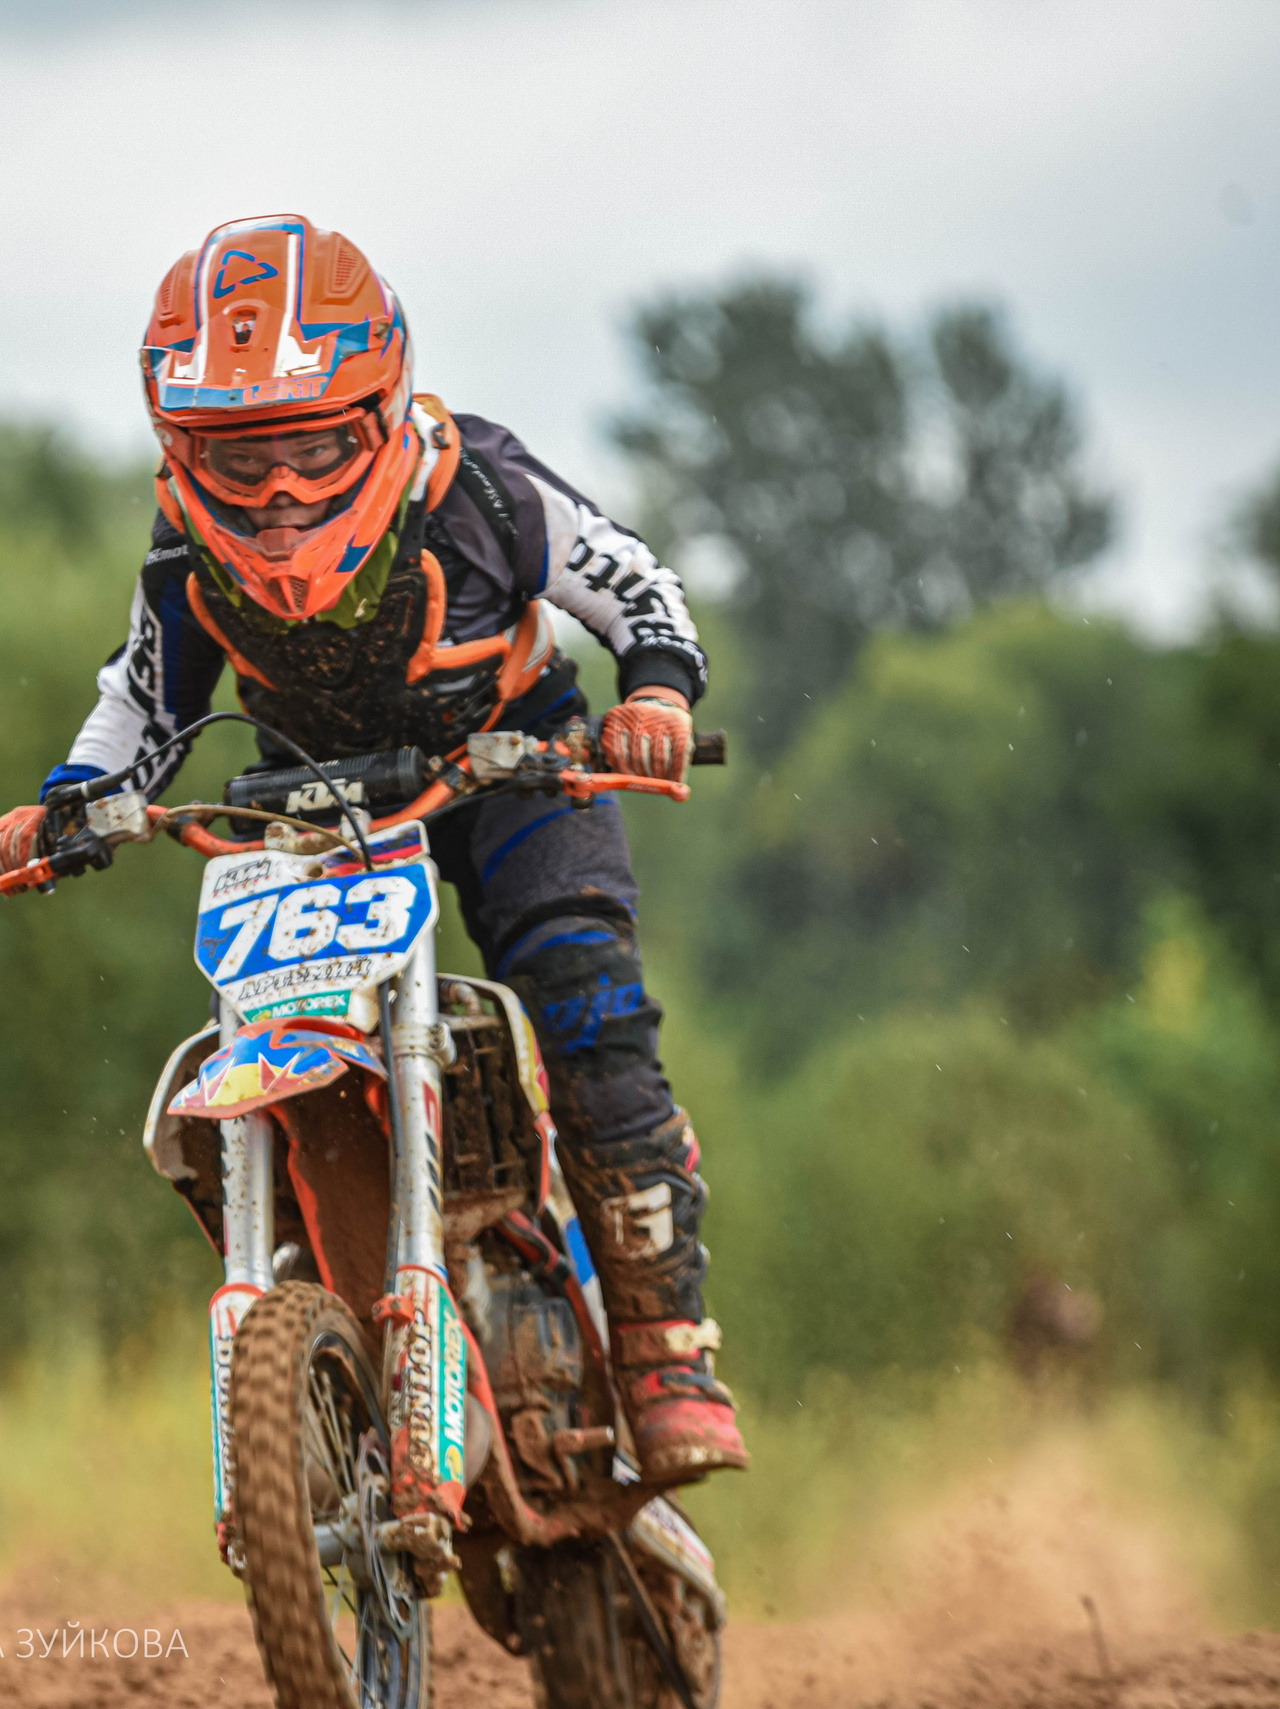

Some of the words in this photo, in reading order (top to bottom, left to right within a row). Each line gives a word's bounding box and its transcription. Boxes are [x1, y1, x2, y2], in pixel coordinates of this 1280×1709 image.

[286, 777, 365, 814] KTM
[212, 875, 418, 982] 763
[443, 1309, 465, 1446] MOTOREX
